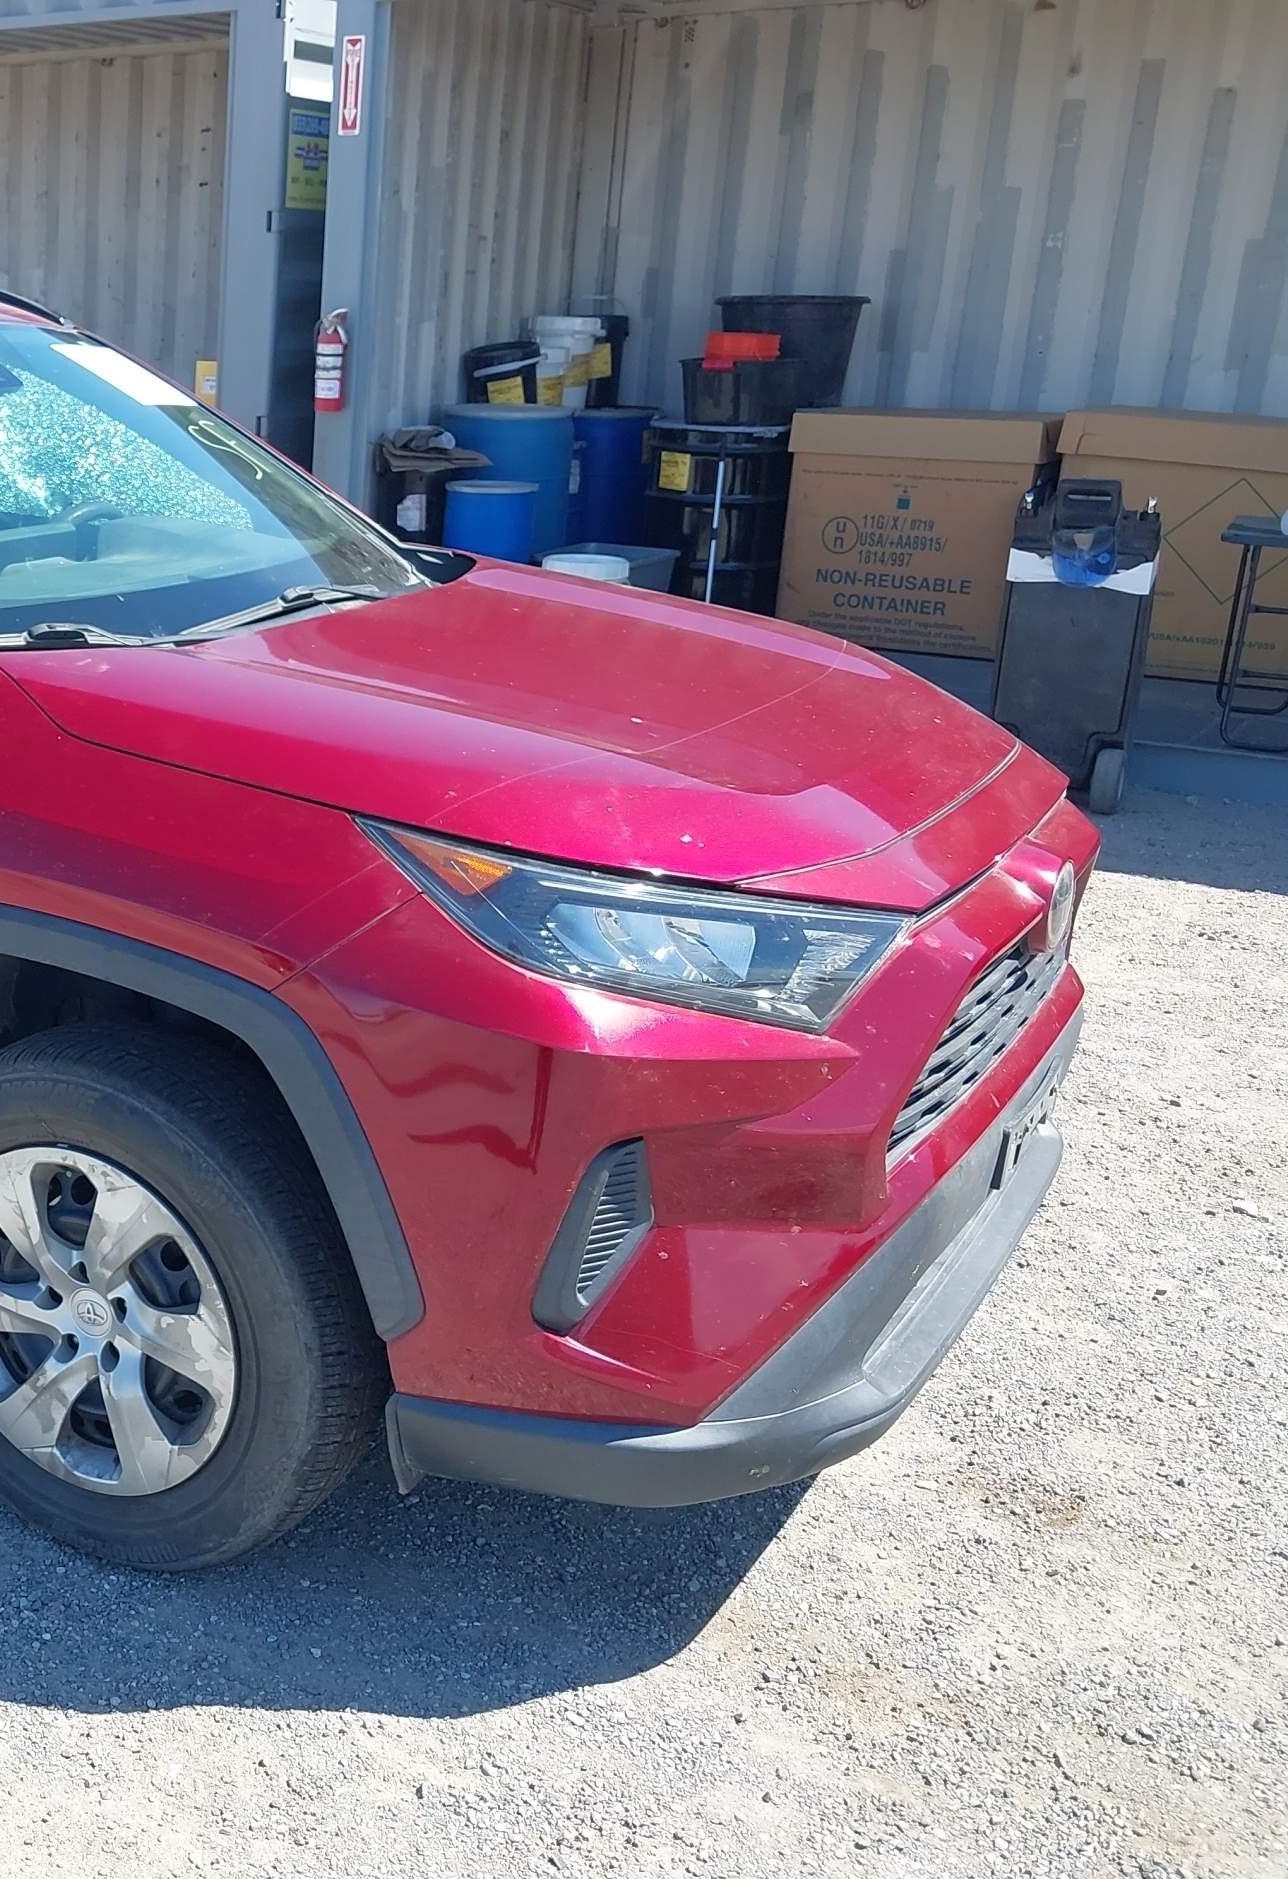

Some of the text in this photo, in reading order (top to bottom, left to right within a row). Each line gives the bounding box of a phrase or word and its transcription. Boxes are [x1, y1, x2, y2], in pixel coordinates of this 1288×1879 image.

[858, 551, 912, 567] 1814/997
[815, 568, 973, 595] NON-REUSABLE
[833, 592, 946, 616] CONTAINER
